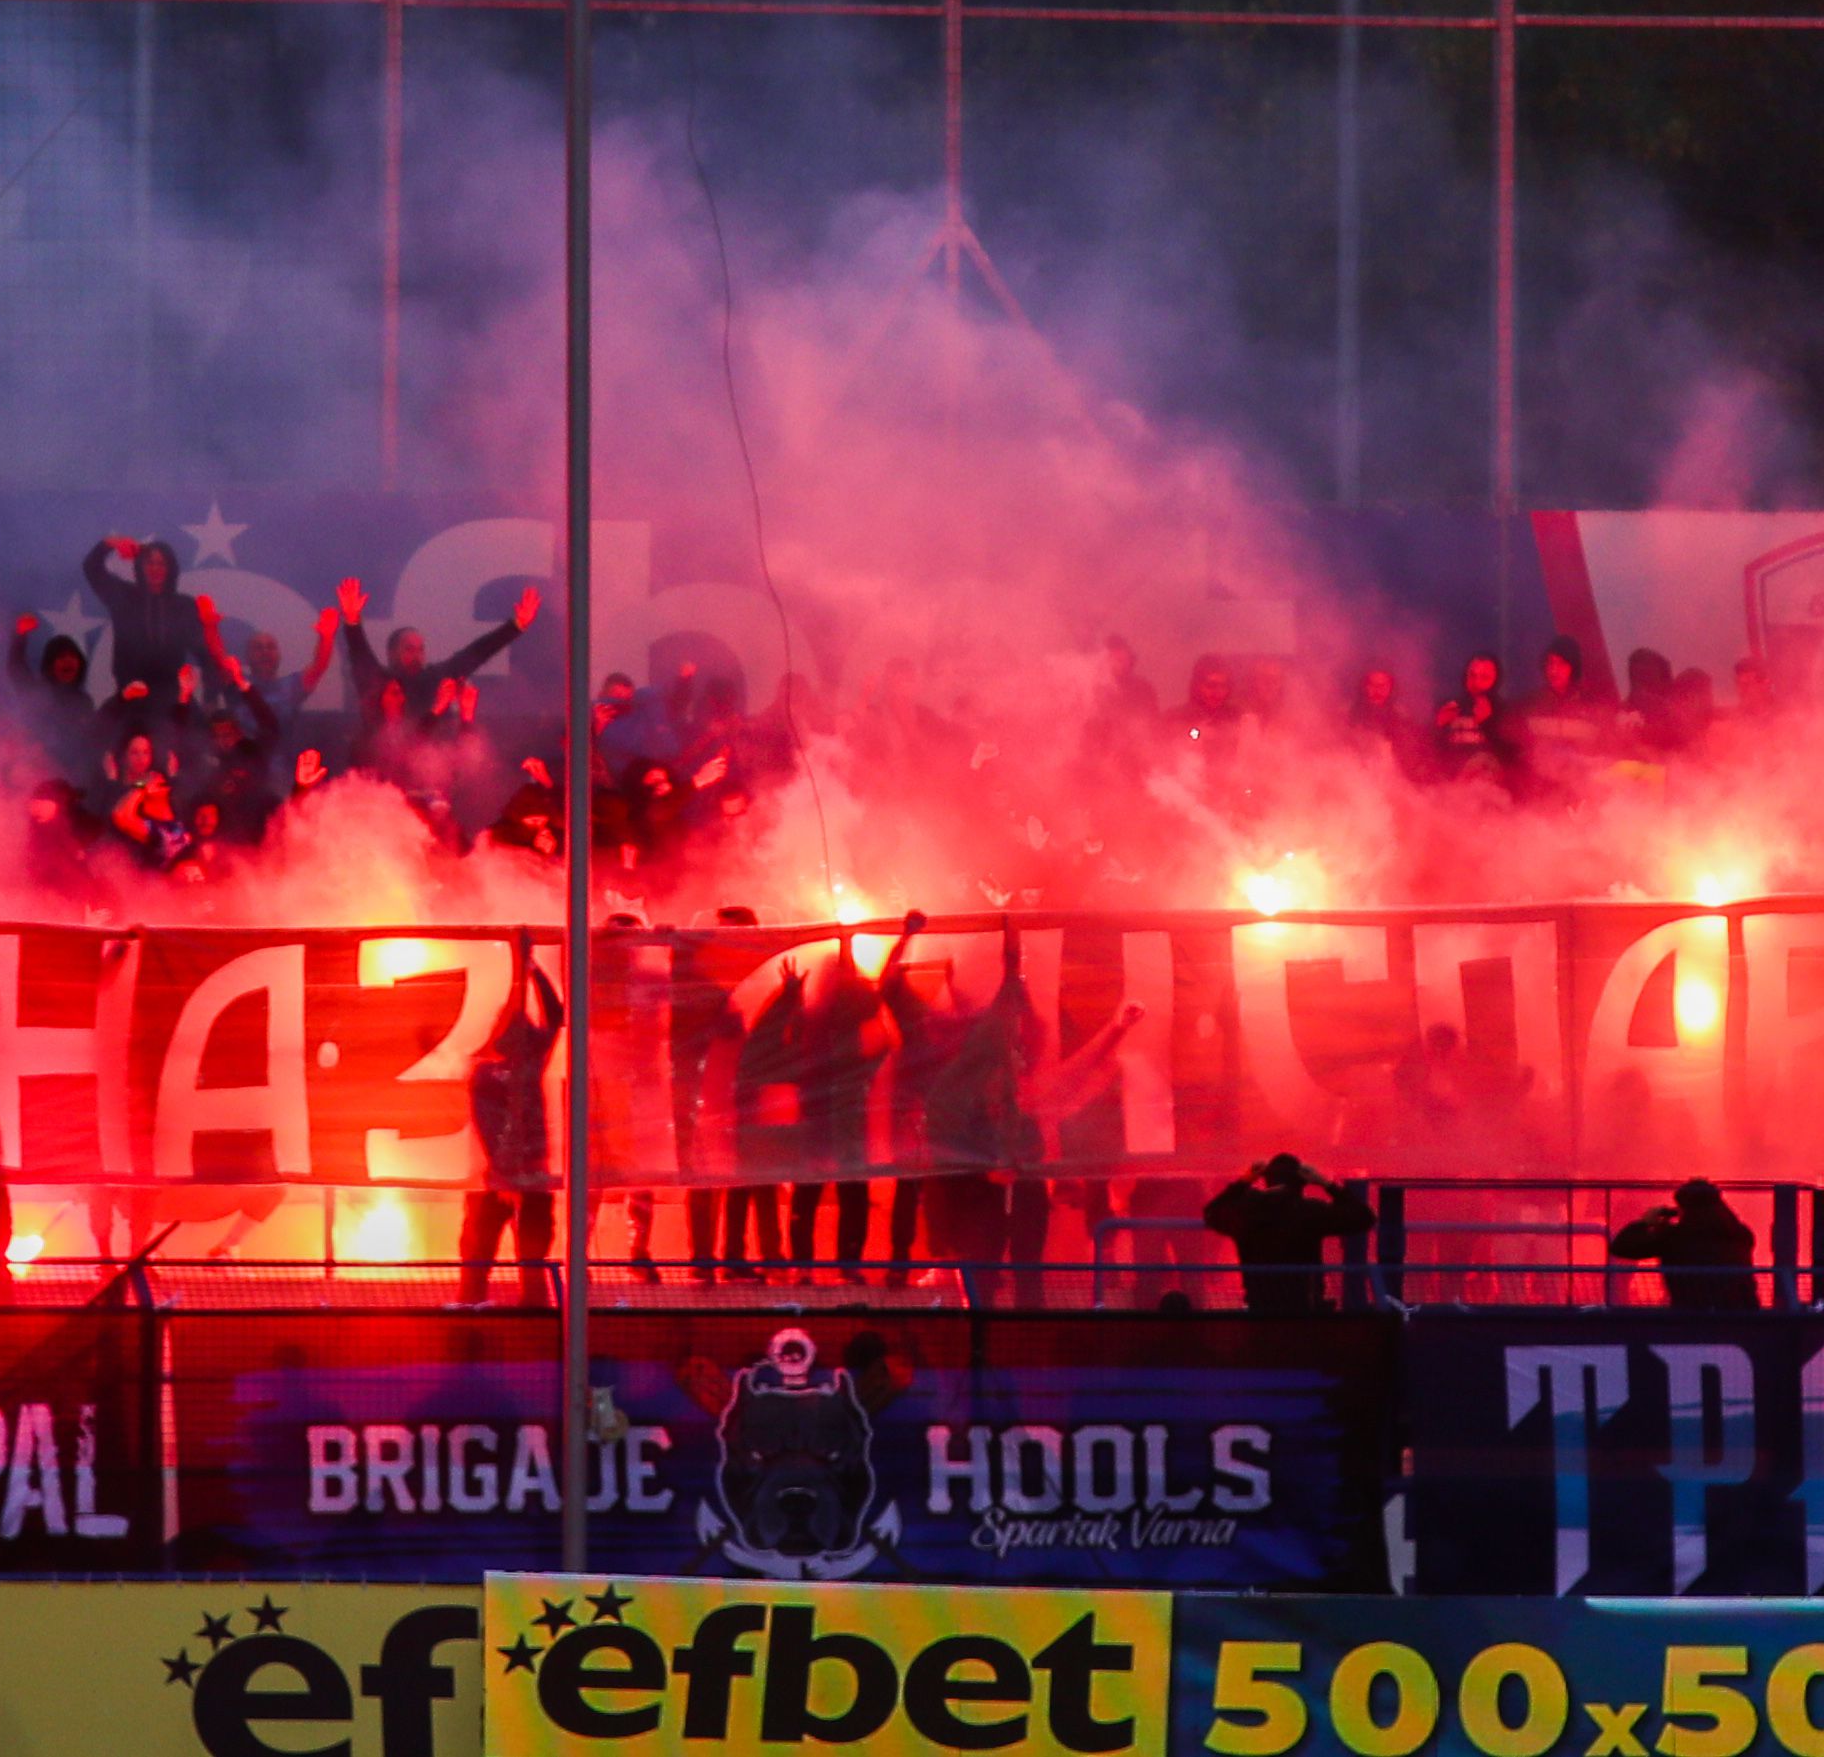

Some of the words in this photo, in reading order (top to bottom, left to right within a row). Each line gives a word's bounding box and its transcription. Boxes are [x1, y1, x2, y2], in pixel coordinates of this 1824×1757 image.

[926, 1423, 1273, 1514] HOOLS
[971, 1504, 1121, 1558] Spartak
[1129, 1502, 1238, 1552] Varna
[538, 1603, 1135, 1755] efbet
